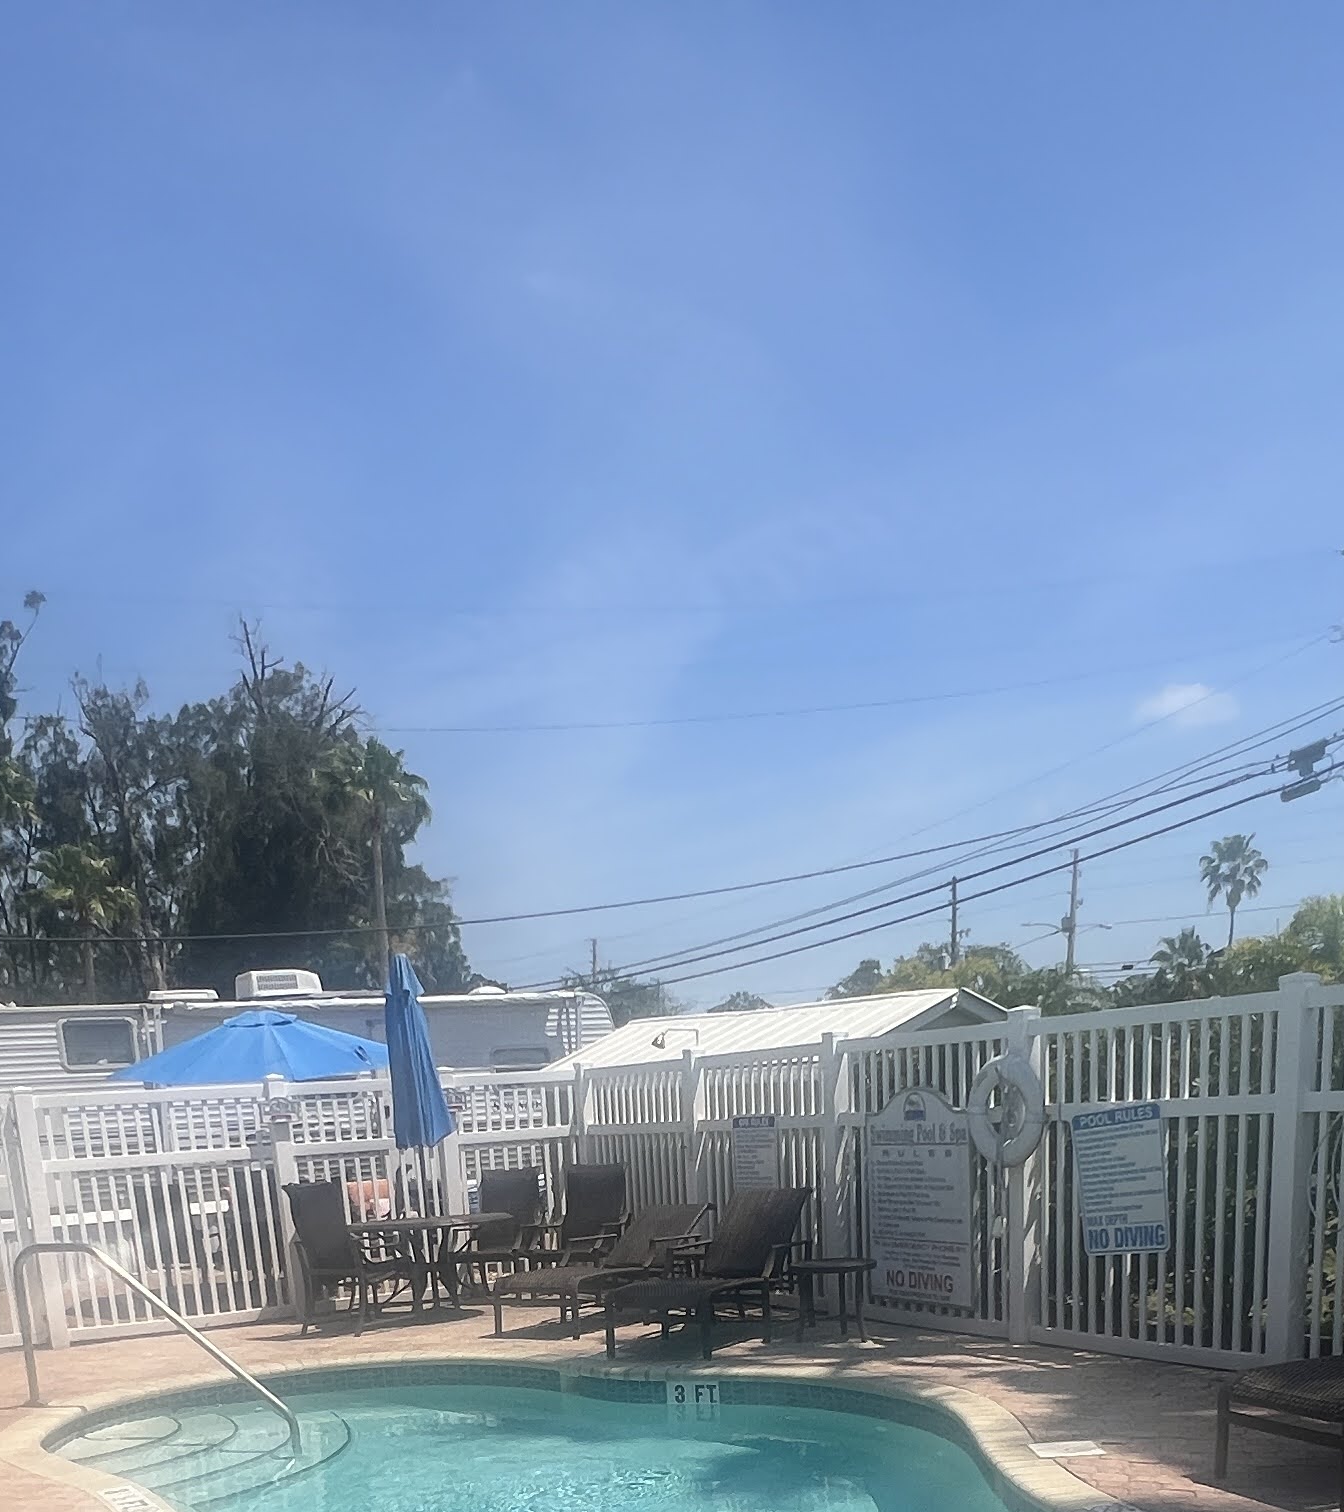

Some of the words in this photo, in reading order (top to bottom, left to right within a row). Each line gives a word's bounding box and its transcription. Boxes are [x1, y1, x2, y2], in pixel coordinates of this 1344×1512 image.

[1079, 1111, 1111, 1128] POOL
[1114, 1106, 1153, 1121] RULES
[916, 1122, 936, 1143] Pool
[949, 1121, 968, 1146] Spa
[1088, 1228, 1110, 1250] NO
[1114, 1224, 1166, 1248] DIVING
[886, 1269, 905, 1287] NO
[908, 1271, 954, 1294] DIVING
[674, 1384, 686, 1404] 3
